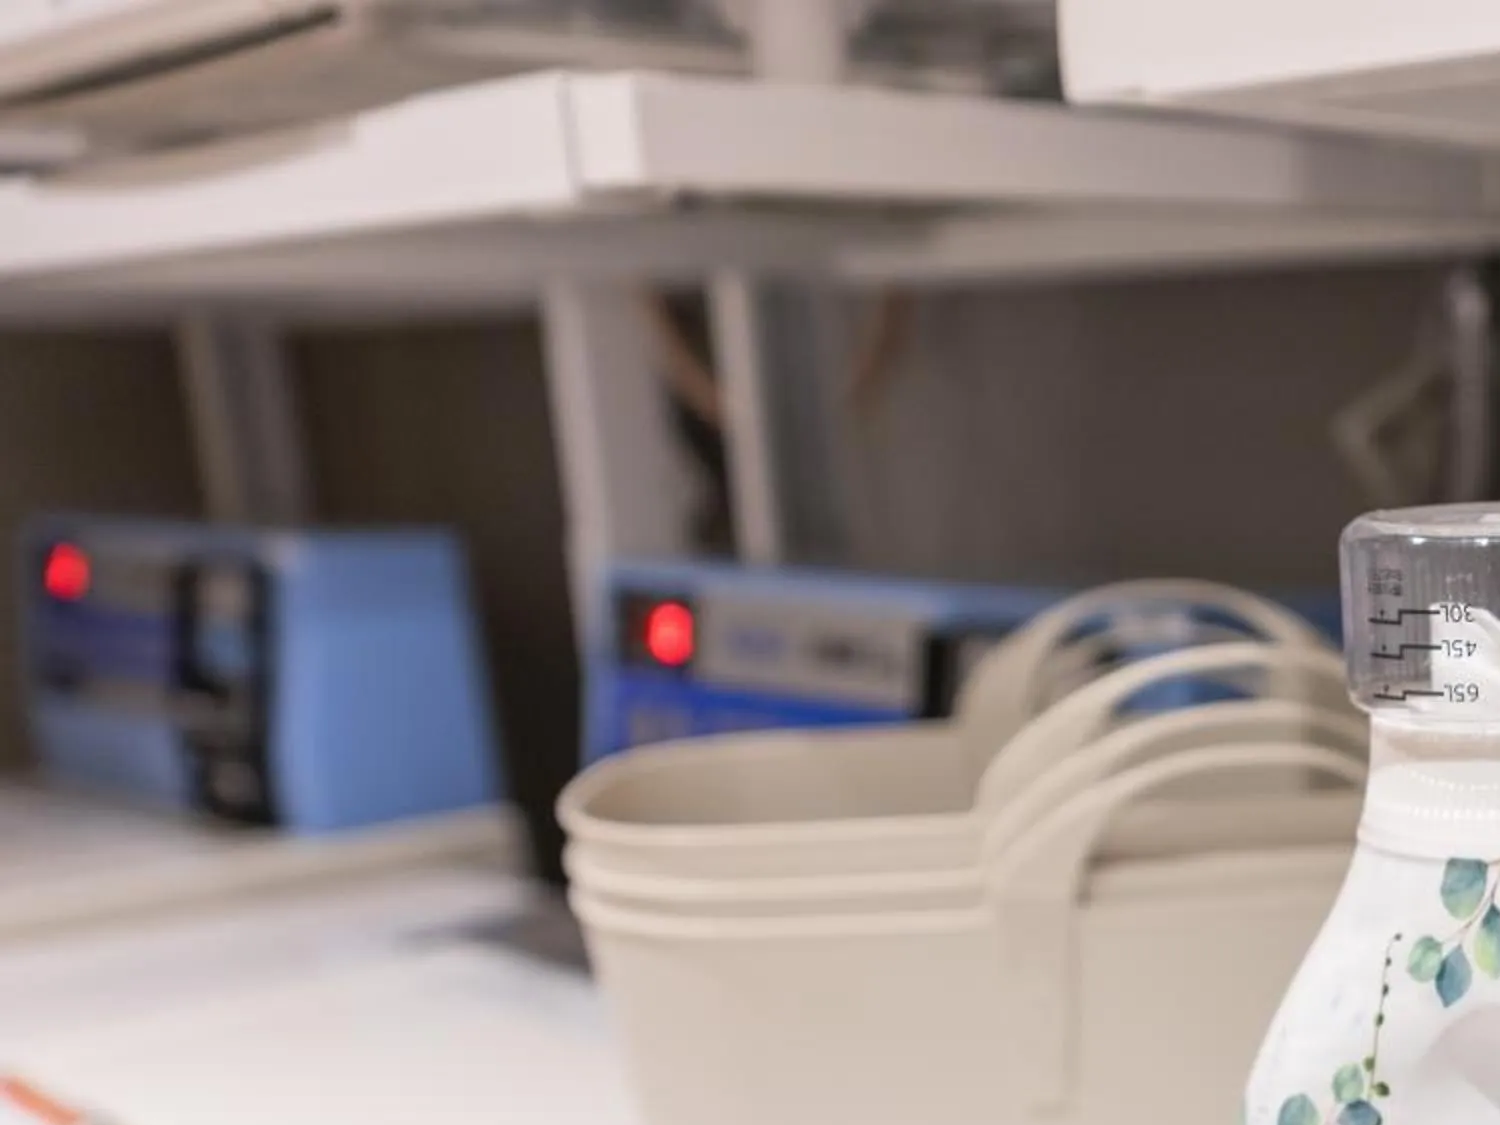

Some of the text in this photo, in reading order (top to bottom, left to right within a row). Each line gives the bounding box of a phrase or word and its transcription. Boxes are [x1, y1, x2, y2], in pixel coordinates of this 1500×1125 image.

[1439, 603, 1475, 623] 30L
[1444, 640, 1477, 658] 45L
[1443, 683, 1479, 702] 65L
